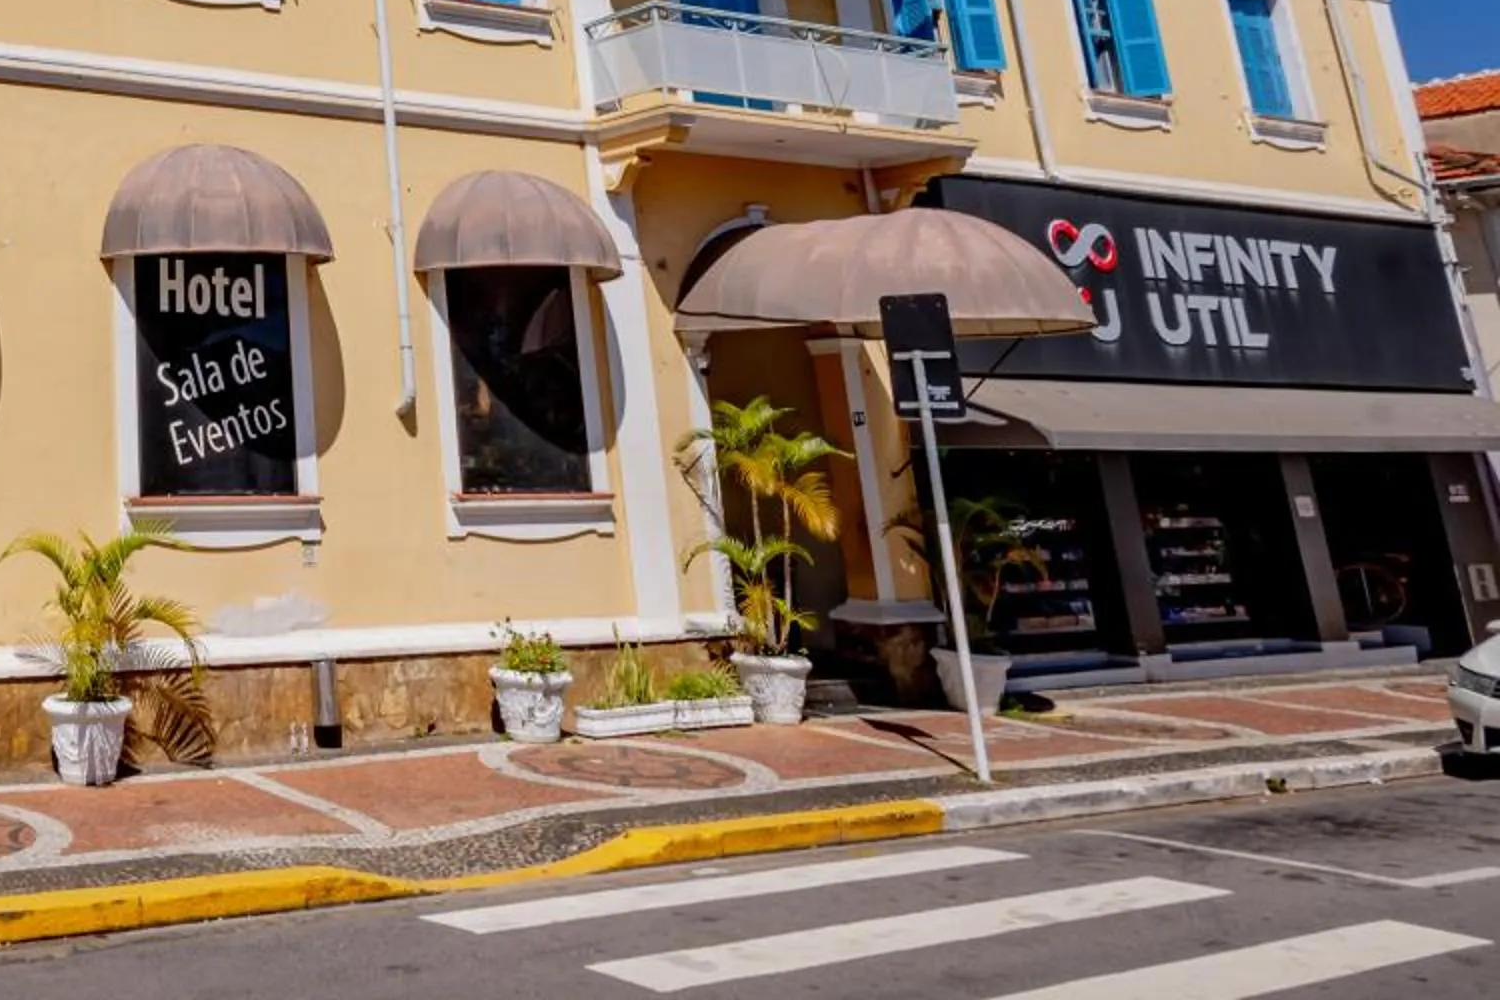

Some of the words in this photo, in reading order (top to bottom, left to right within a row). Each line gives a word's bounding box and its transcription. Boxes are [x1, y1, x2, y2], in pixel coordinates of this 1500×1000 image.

[159, 257, 265, 319] Hotel
[1133, 227, 1337, 293] INFINITY
[1146, 291, 1269, 347] UTIL
[156, 353, 224, 406] Sala
[230, 340, 267, 385] de
[169, 399, 287, 465] Eventos
